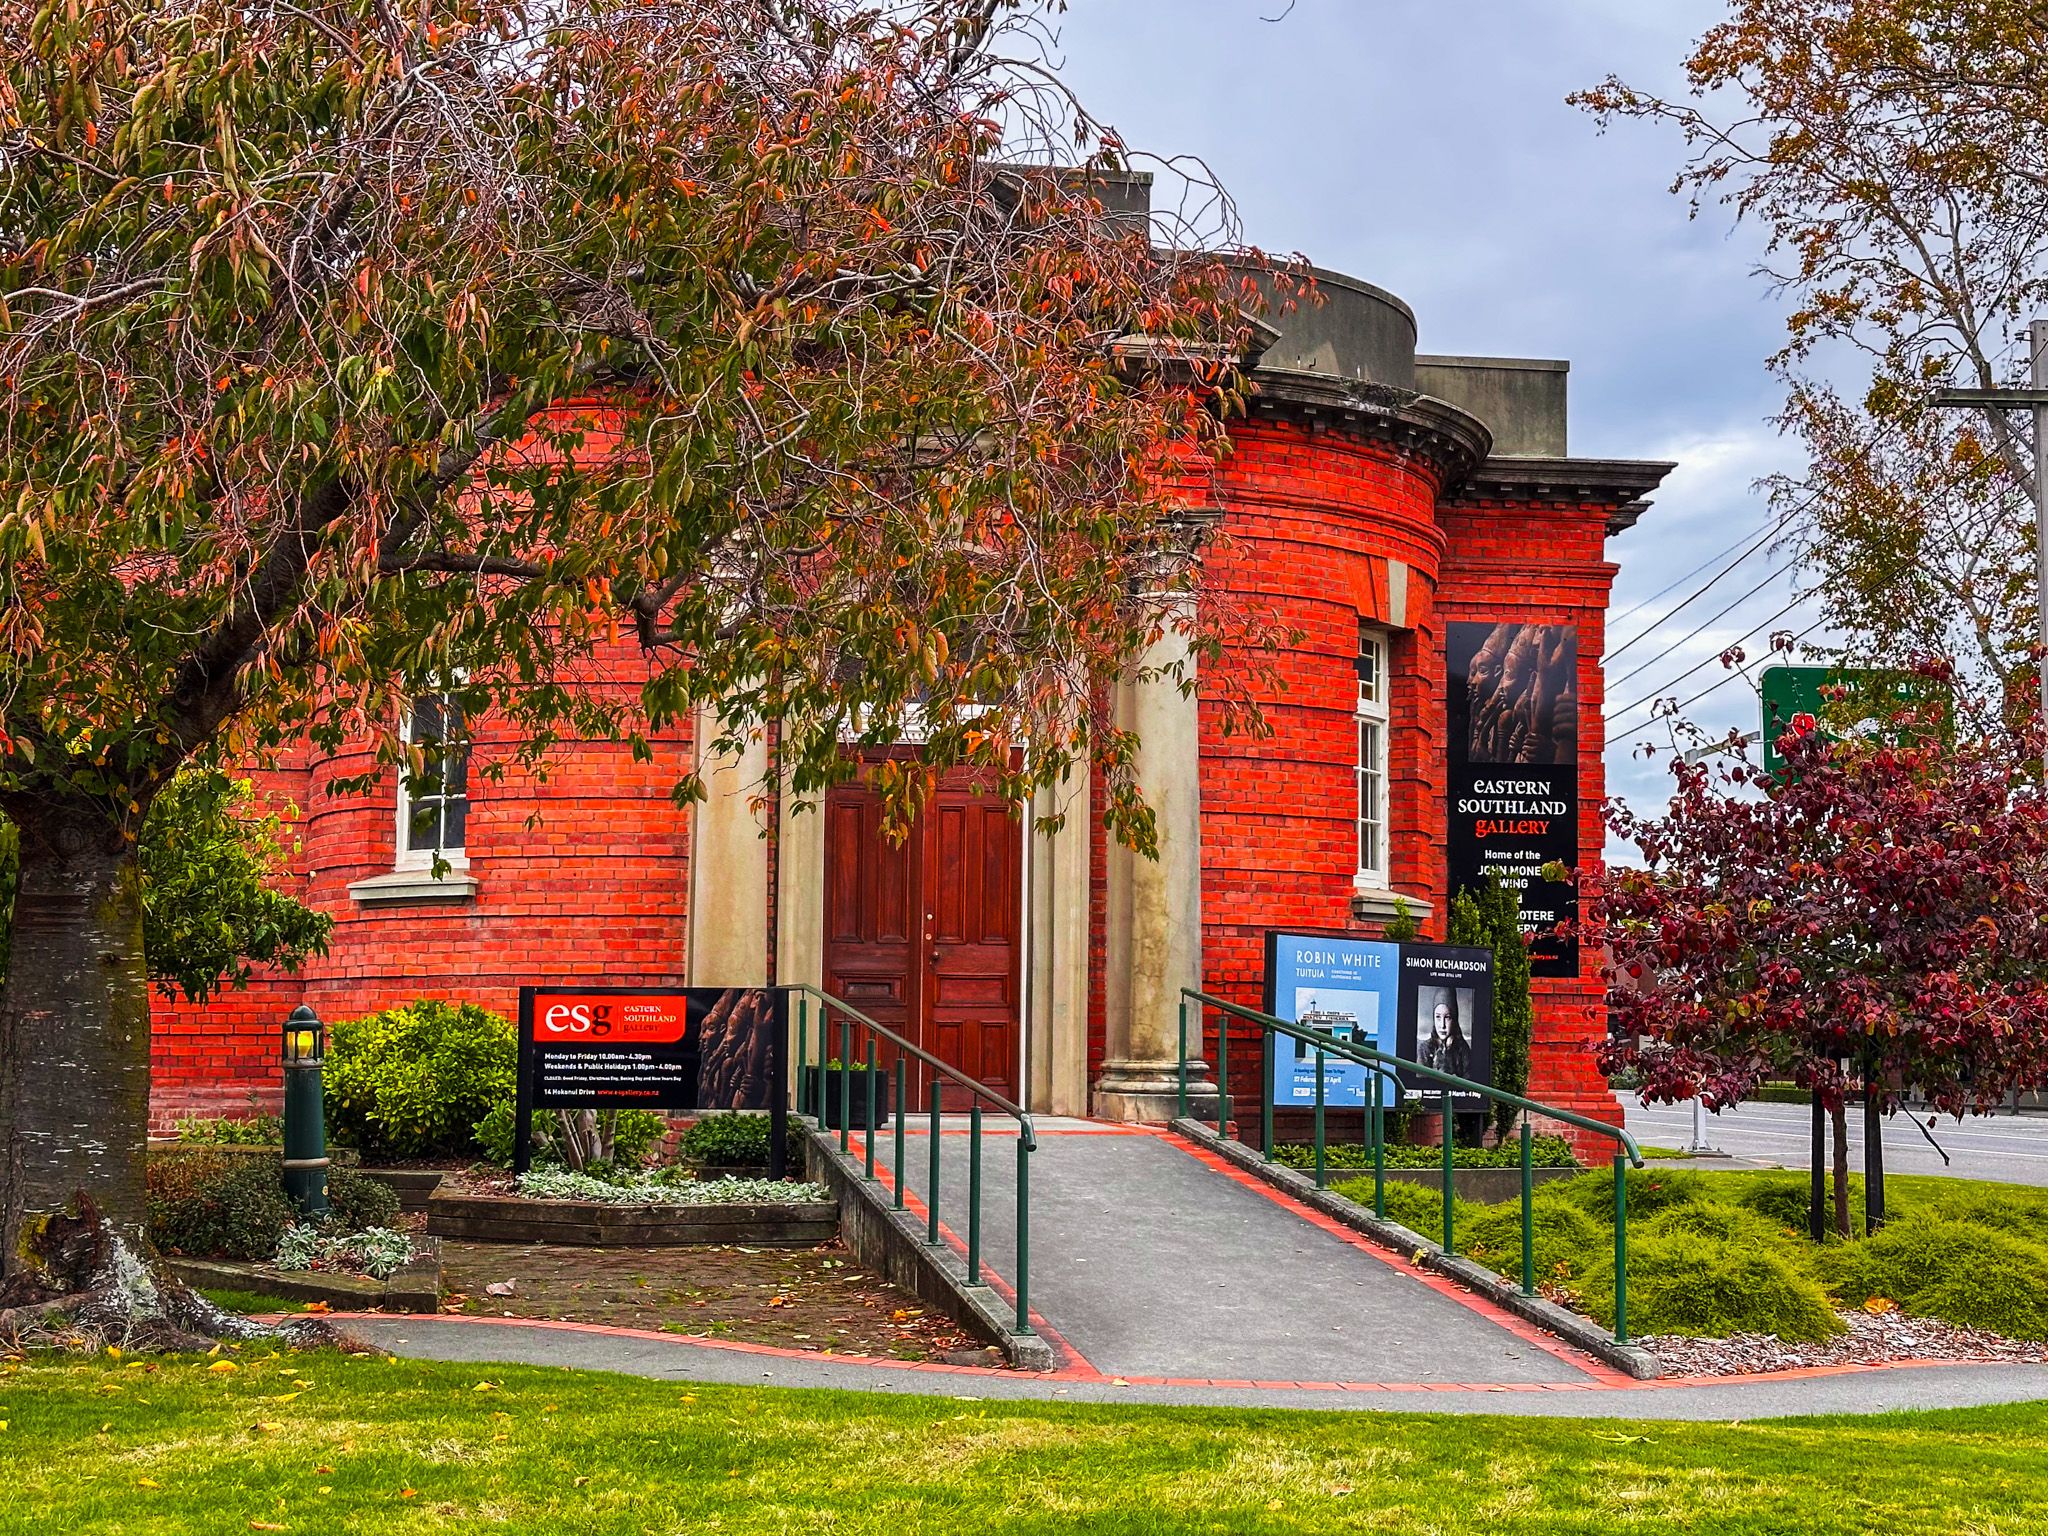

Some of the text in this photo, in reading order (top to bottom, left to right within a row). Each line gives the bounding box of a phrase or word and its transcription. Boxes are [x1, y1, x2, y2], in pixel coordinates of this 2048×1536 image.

[1458, 799, 1567, 815] SOUTHLAND
[1484, 849, 1541, 860] Home of the
[1509, 866, 1542, 876] MONE
[1515, 910, 1555, 921] OTERE
[1296, 950, 1381, 968] ROBIN WHITE
[1406, 957, 1487, 972] SIMON RICHARDSON
[1296, 967, 1325, 978] TUITUIA
[545, 1004, 613, 1037] esg
[623, 1014, 677, 1023] SOUTHLAND
[544, 1053, 569, 1061] Monday
[577, 1053, 598, 1061] Friday
[604, 1063, 632, 1071] Holidays
